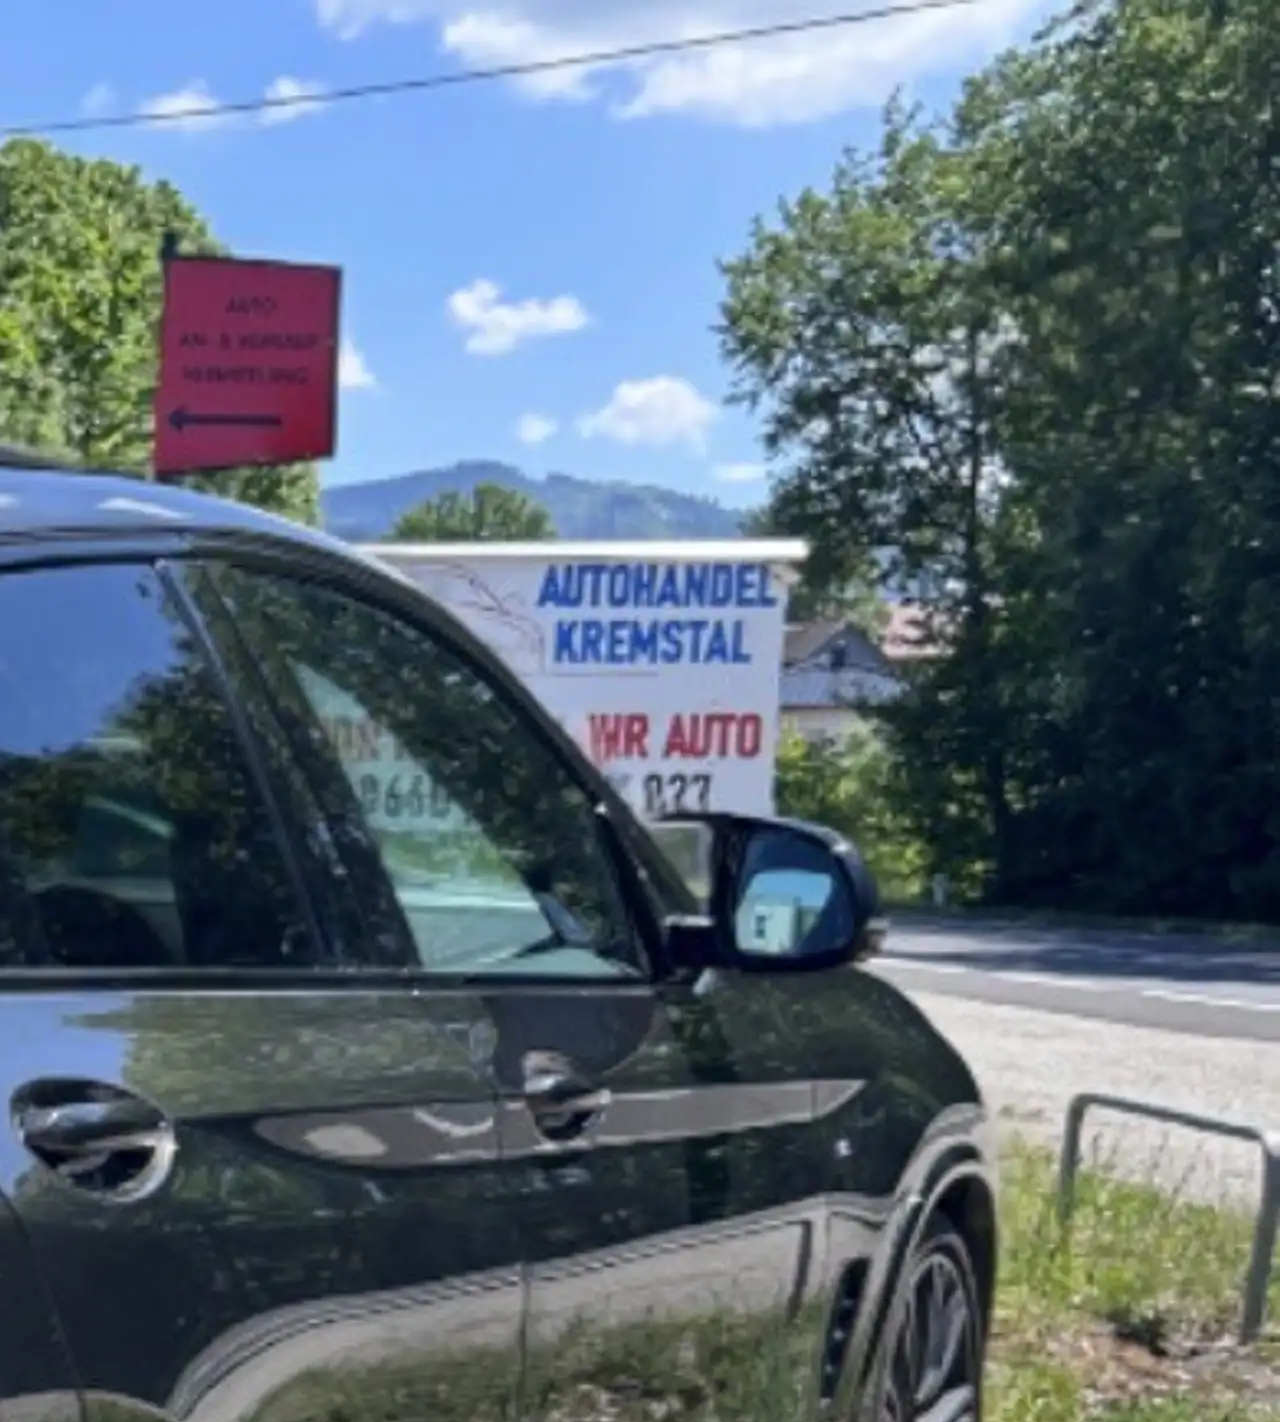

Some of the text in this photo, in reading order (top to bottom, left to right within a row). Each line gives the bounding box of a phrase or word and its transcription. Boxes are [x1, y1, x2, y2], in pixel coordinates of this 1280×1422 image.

[537, 563, 777, 608] AUTOHANDEL
[553, 619, 752, 664] KREMSTAL
[660, 712, 763, 758] AUTO
